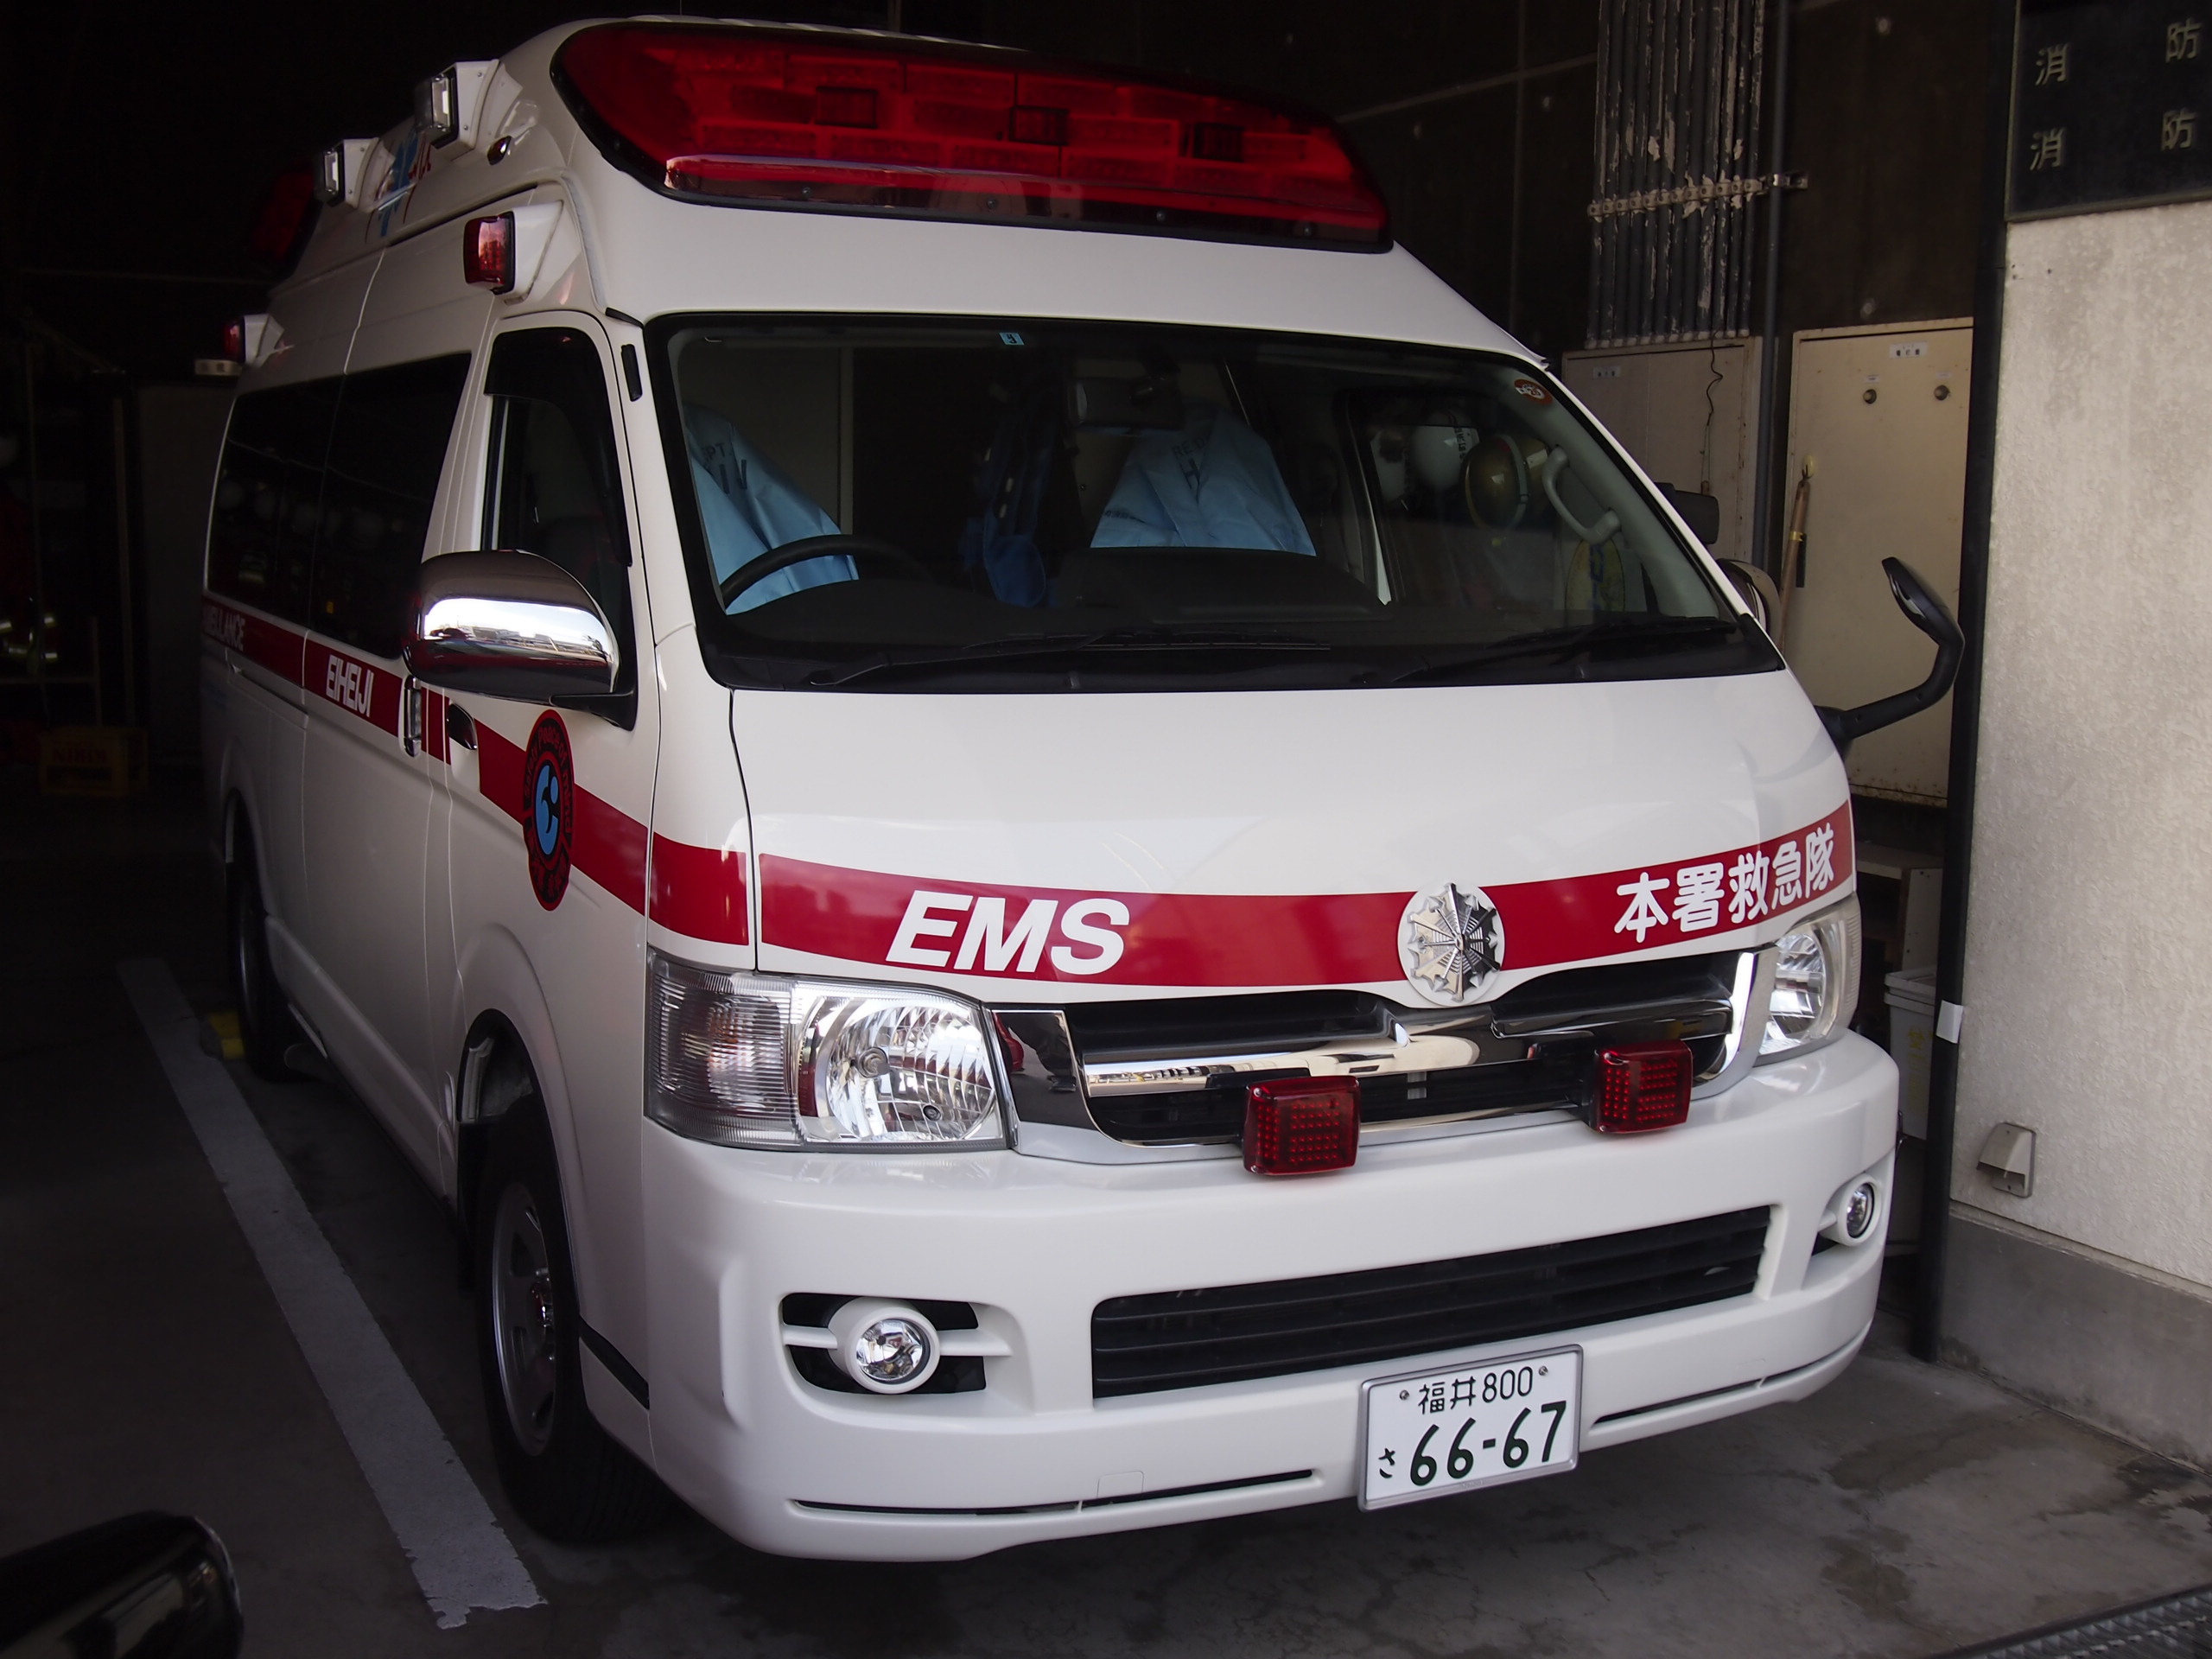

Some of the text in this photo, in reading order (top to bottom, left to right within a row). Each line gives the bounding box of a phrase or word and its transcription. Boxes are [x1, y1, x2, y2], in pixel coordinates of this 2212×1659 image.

[202, 602, 246, 652] MBULANCE
[326, 653, 375, 718] EIHEIJI
[1613, 822, 1834, 944] 本署救急隊
[885, 889, 1130, 976] EMS
[1410, 1400, 1567, 1486] 66-67
